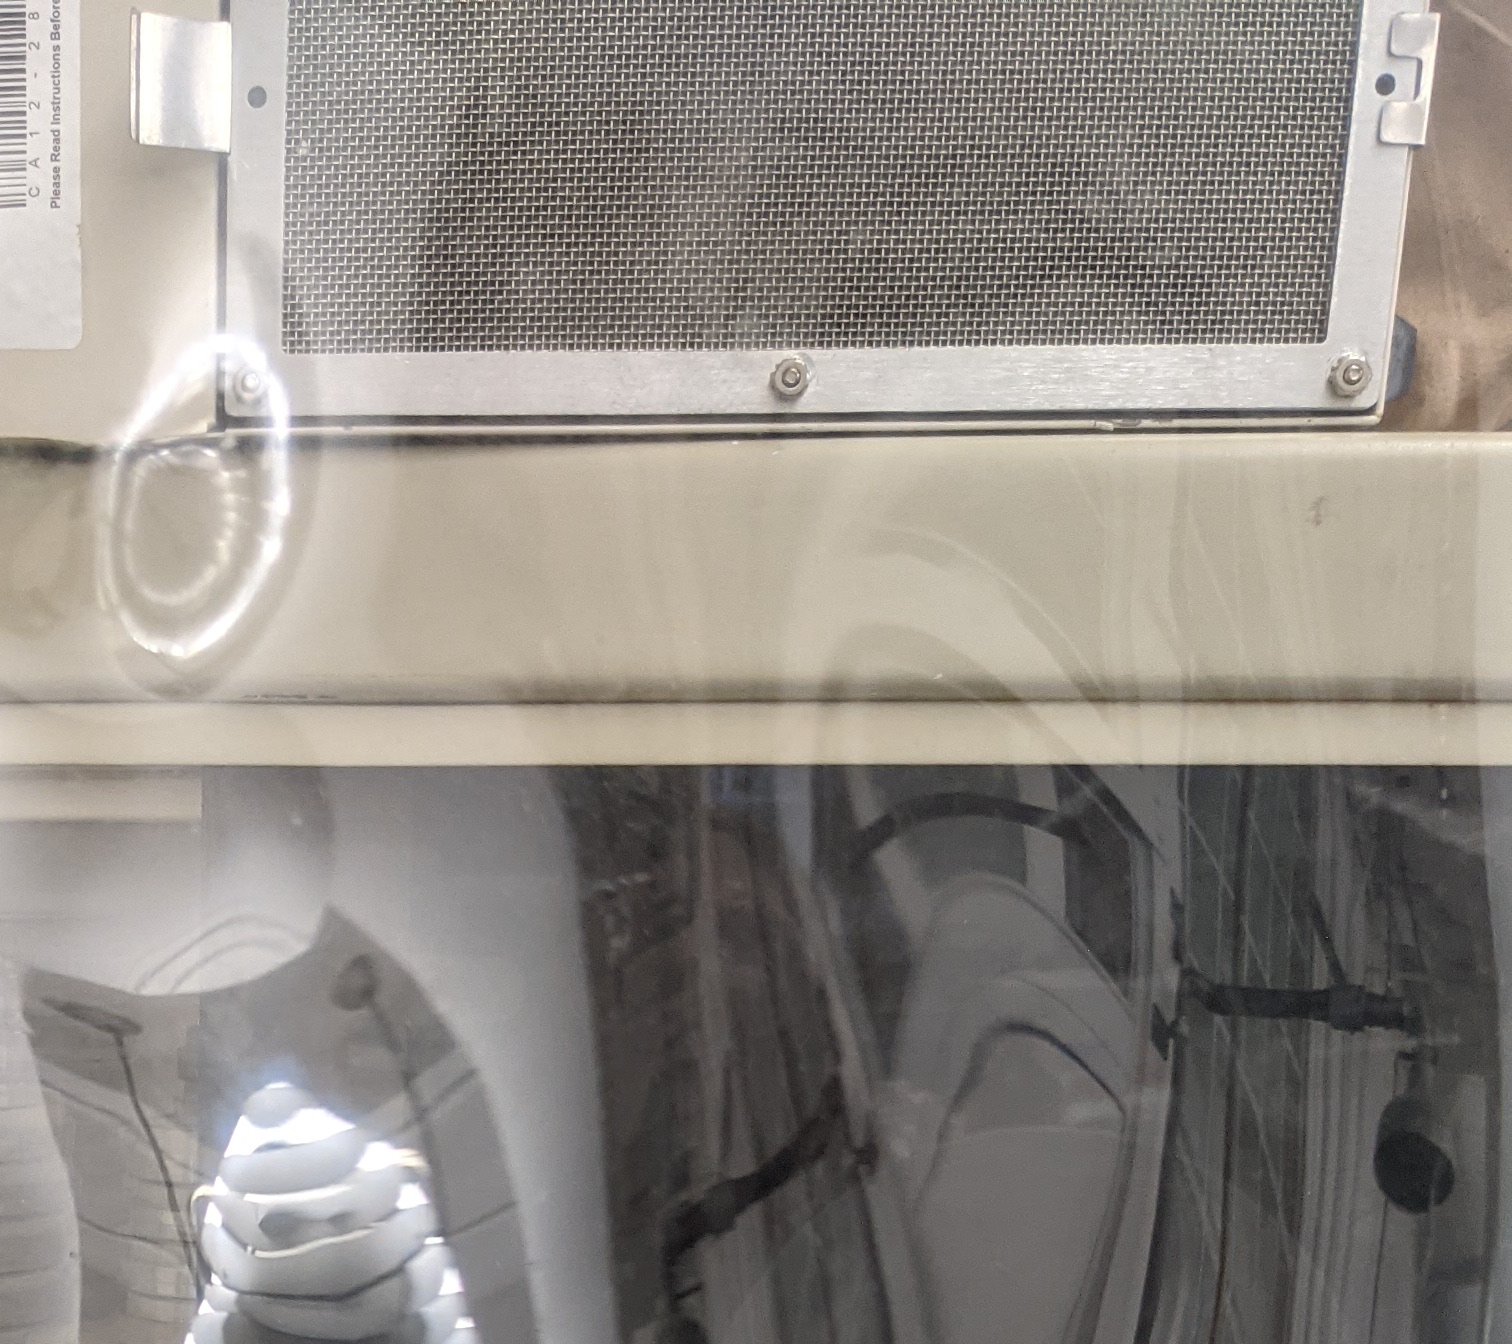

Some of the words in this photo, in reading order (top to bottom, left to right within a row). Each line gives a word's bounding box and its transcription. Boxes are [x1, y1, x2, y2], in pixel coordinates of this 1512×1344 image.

[50, 44, 62, 125] Instructions
[50, 127, 62, 163] Read
[50, 166, 62, 209] Please
